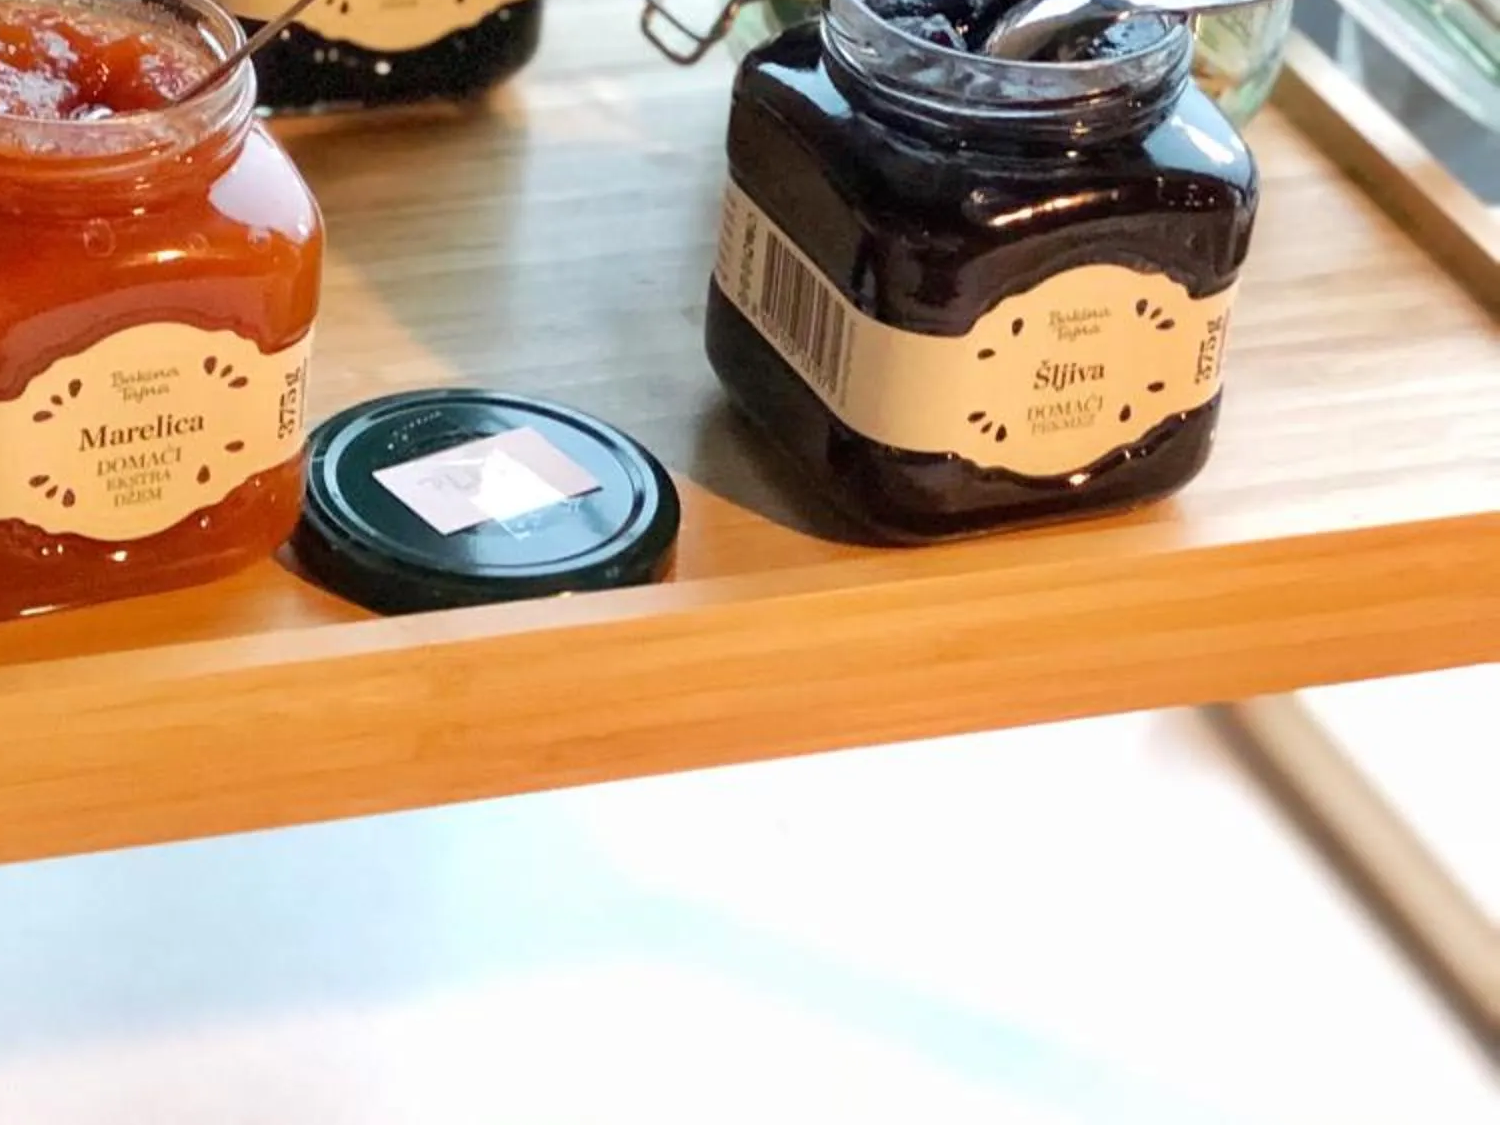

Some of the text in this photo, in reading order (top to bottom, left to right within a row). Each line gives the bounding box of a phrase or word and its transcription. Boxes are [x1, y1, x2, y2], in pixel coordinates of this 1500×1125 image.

[1032, 358, 1106, 393] Šljiva
[277, 366, 302, 440] 375g
[78, 412, 206, 453] Marelica
[106, 468, 173, 492] EKSTRA
